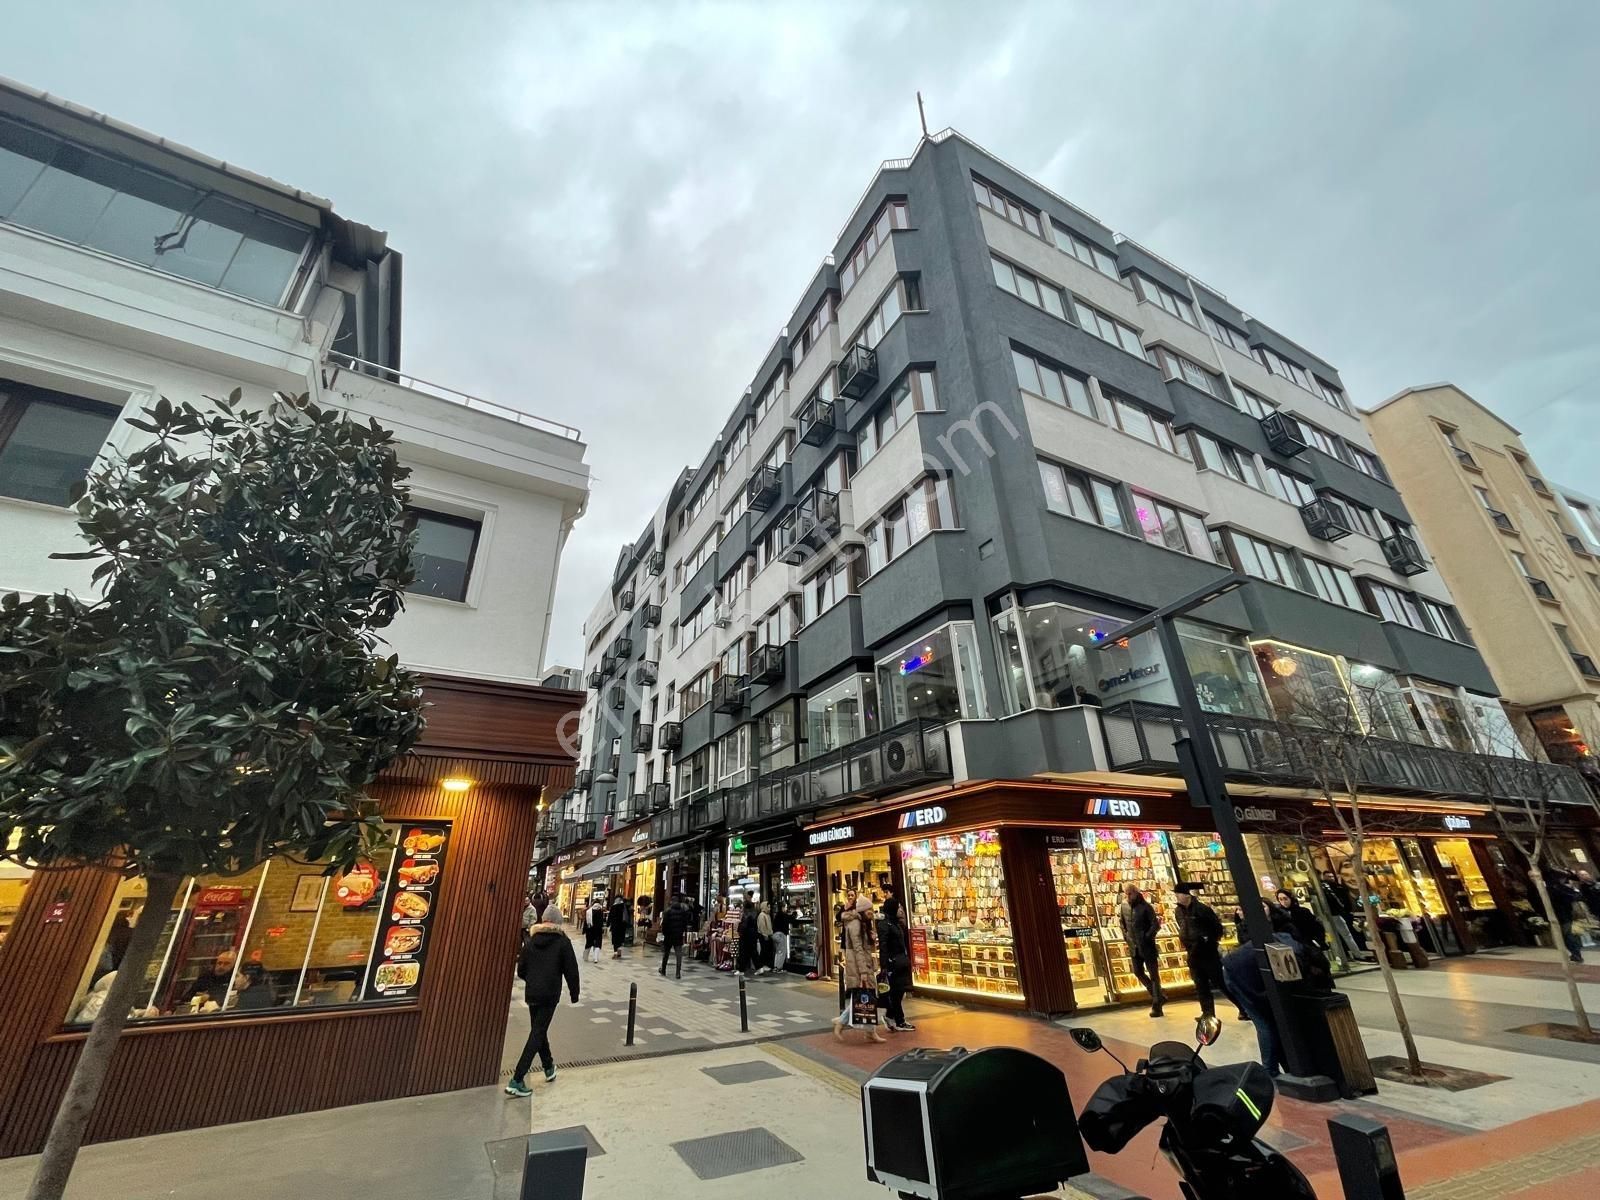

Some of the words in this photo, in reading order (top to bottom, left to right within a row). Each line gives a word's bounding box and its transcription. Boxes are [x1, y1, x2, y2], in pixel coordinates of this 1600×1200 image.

[916, 806, 944, 826] ERD
[1109, 799, 1140, 816] ERD
[809, 831, 828, 845] ORHAN
